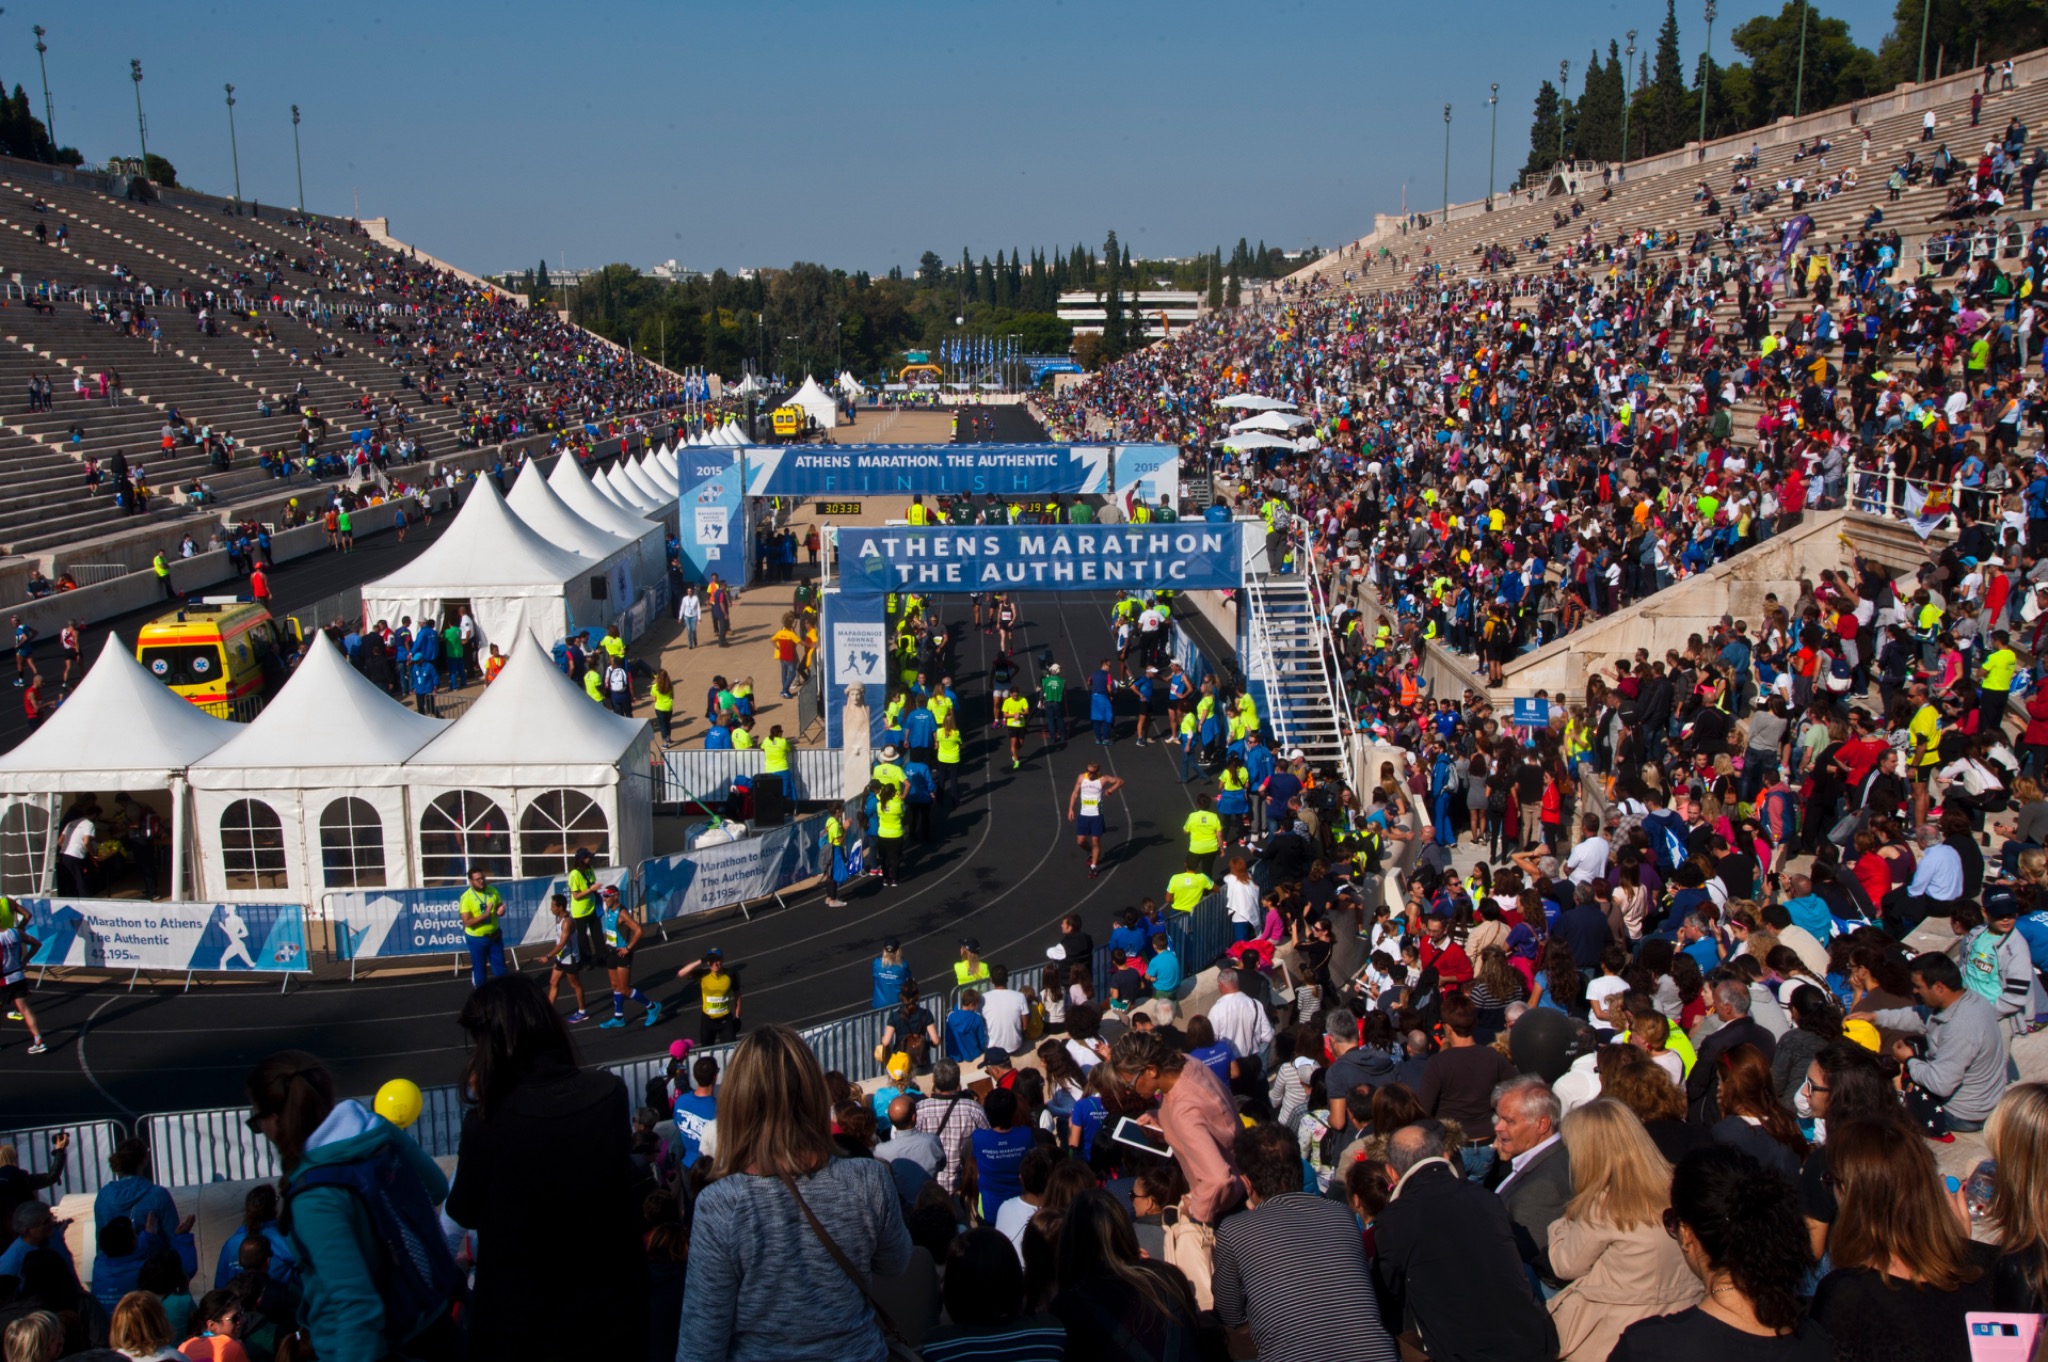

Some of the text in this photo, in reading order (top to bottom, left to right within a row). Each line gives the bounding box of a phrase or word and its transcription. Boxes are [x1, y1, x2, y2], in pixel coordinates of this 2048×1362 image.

[794, 453, 1058, 468] ATHENS MARATHON. THE AUTHENTIC
[1134, 462, 1160, 473] 2015
[696, 466, 723, 477] 2015
[825, 475, 1029, 491] FINISH
[858, 533, 1222, 558] ATHENS MARATHON
[895, 560, 1186, 583] THE AUTHENTIC
[700, 845, 786, 873] Marathon to Athens
[701, 866, 766, 888] The Authentic
[86, 915, 203, 929] Marathon to Athens
[413, 918, 464, 931] Αθήνας
[88, 932, 170, 945] The Authentic
